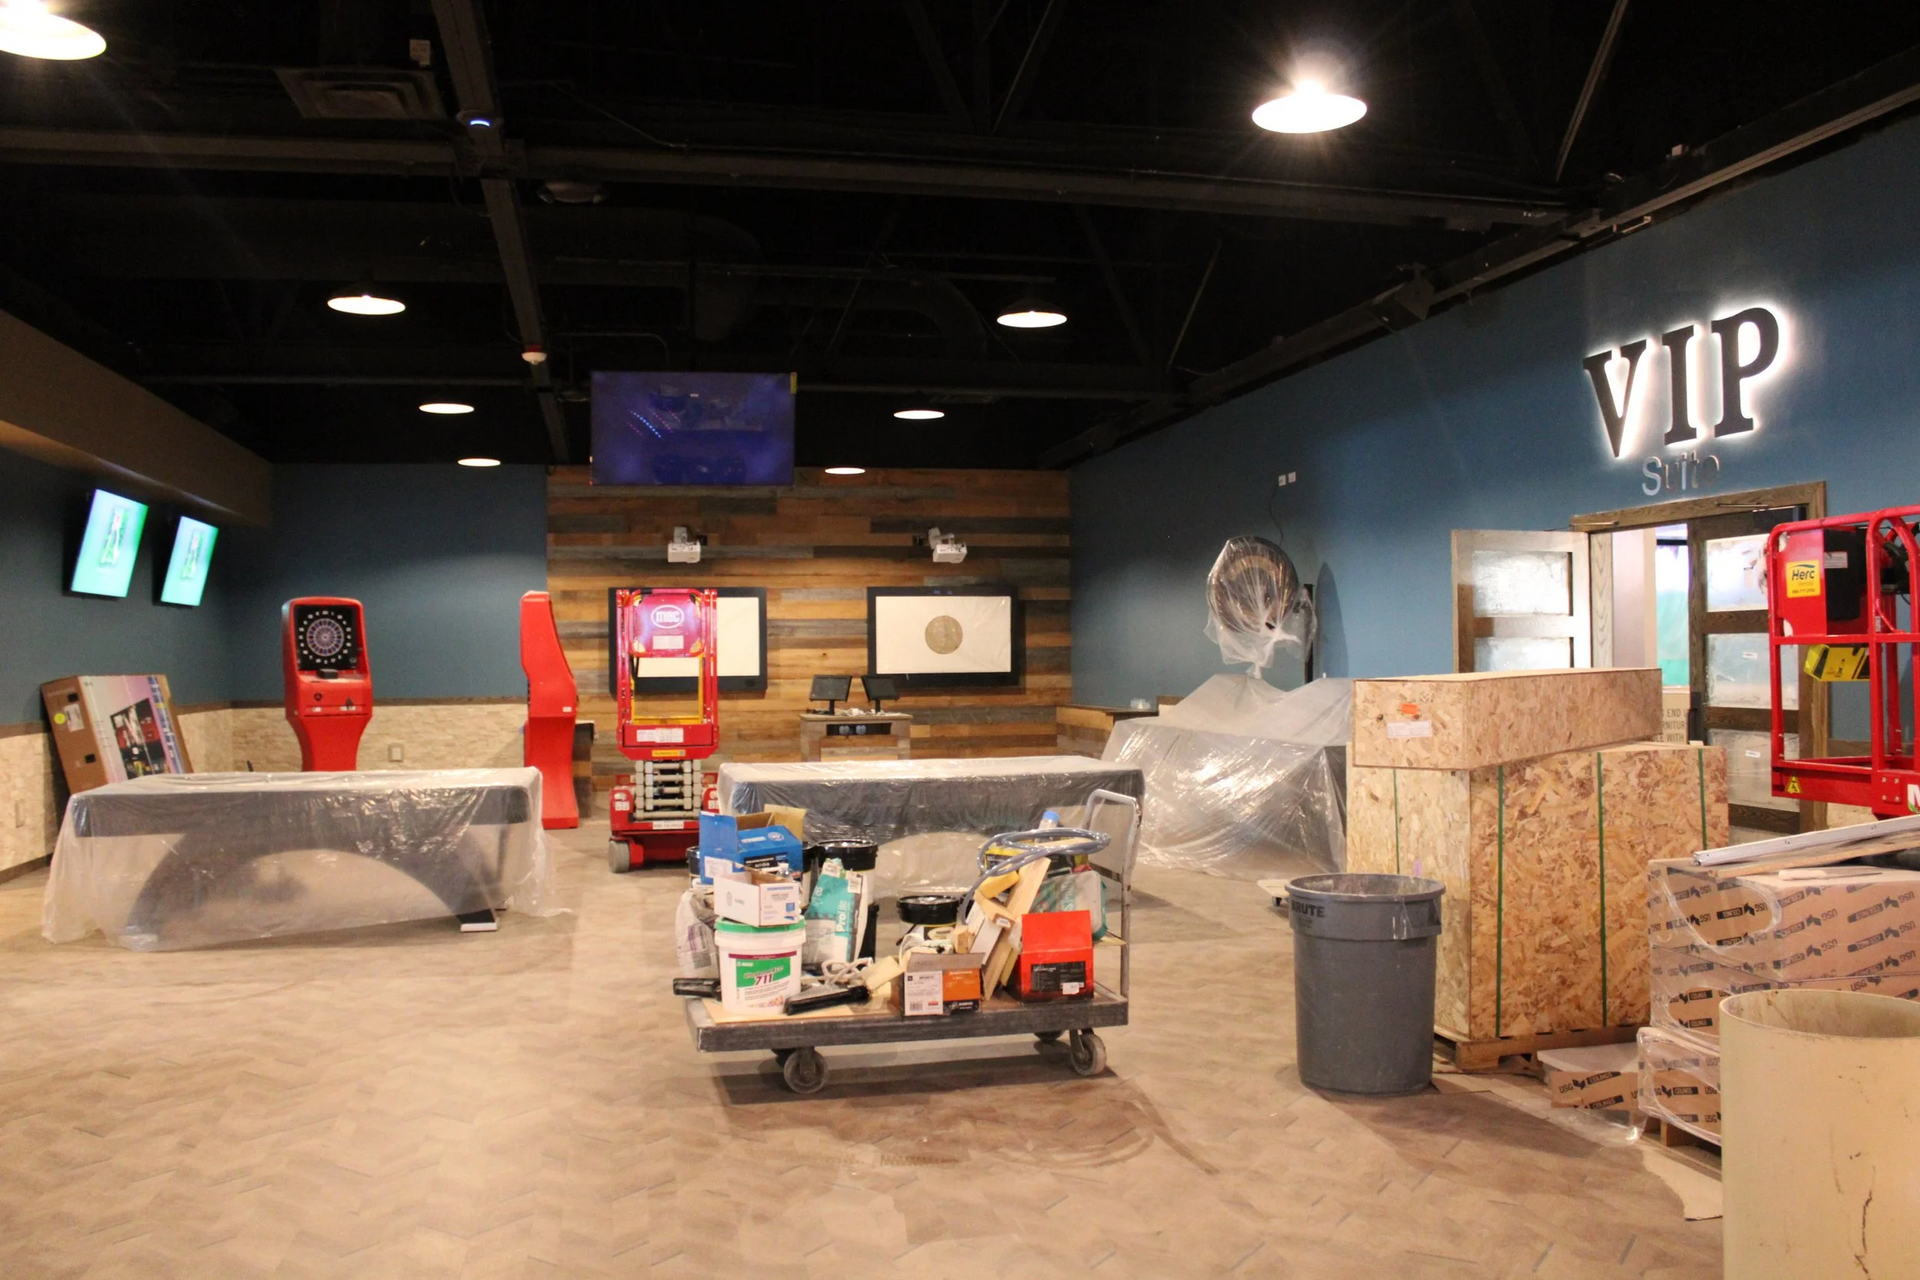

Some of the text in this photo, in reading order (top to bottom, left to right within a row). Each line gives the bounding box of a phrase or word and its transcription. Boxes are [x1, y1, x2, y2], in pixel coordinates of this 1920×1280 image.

[1583, 307, 1779, 458] VIP
[1642, 450, 1720, 496] Suite
[1791, 569, 1815, 581] Herc
[1662, 721, 1686, 730] RNITUR
[1898, 891, 1916, 904] USG
[1291, 900, 1325, 918] BRUTE
[1755, 902, 1768, 912] USG
[1821, 908, 1838, 921] USG
[1899, 920, 1916, 933] USG
[1821, 938, 1838, 951] USG
[1899, 950, 1916, 963] USG
[755, 973, 773, 986] 711
[1850, 980, 1868, 992] USG
[1559, 1083, 1574, 1094] USG
[1705, 1114, 1717, 1123] USG
